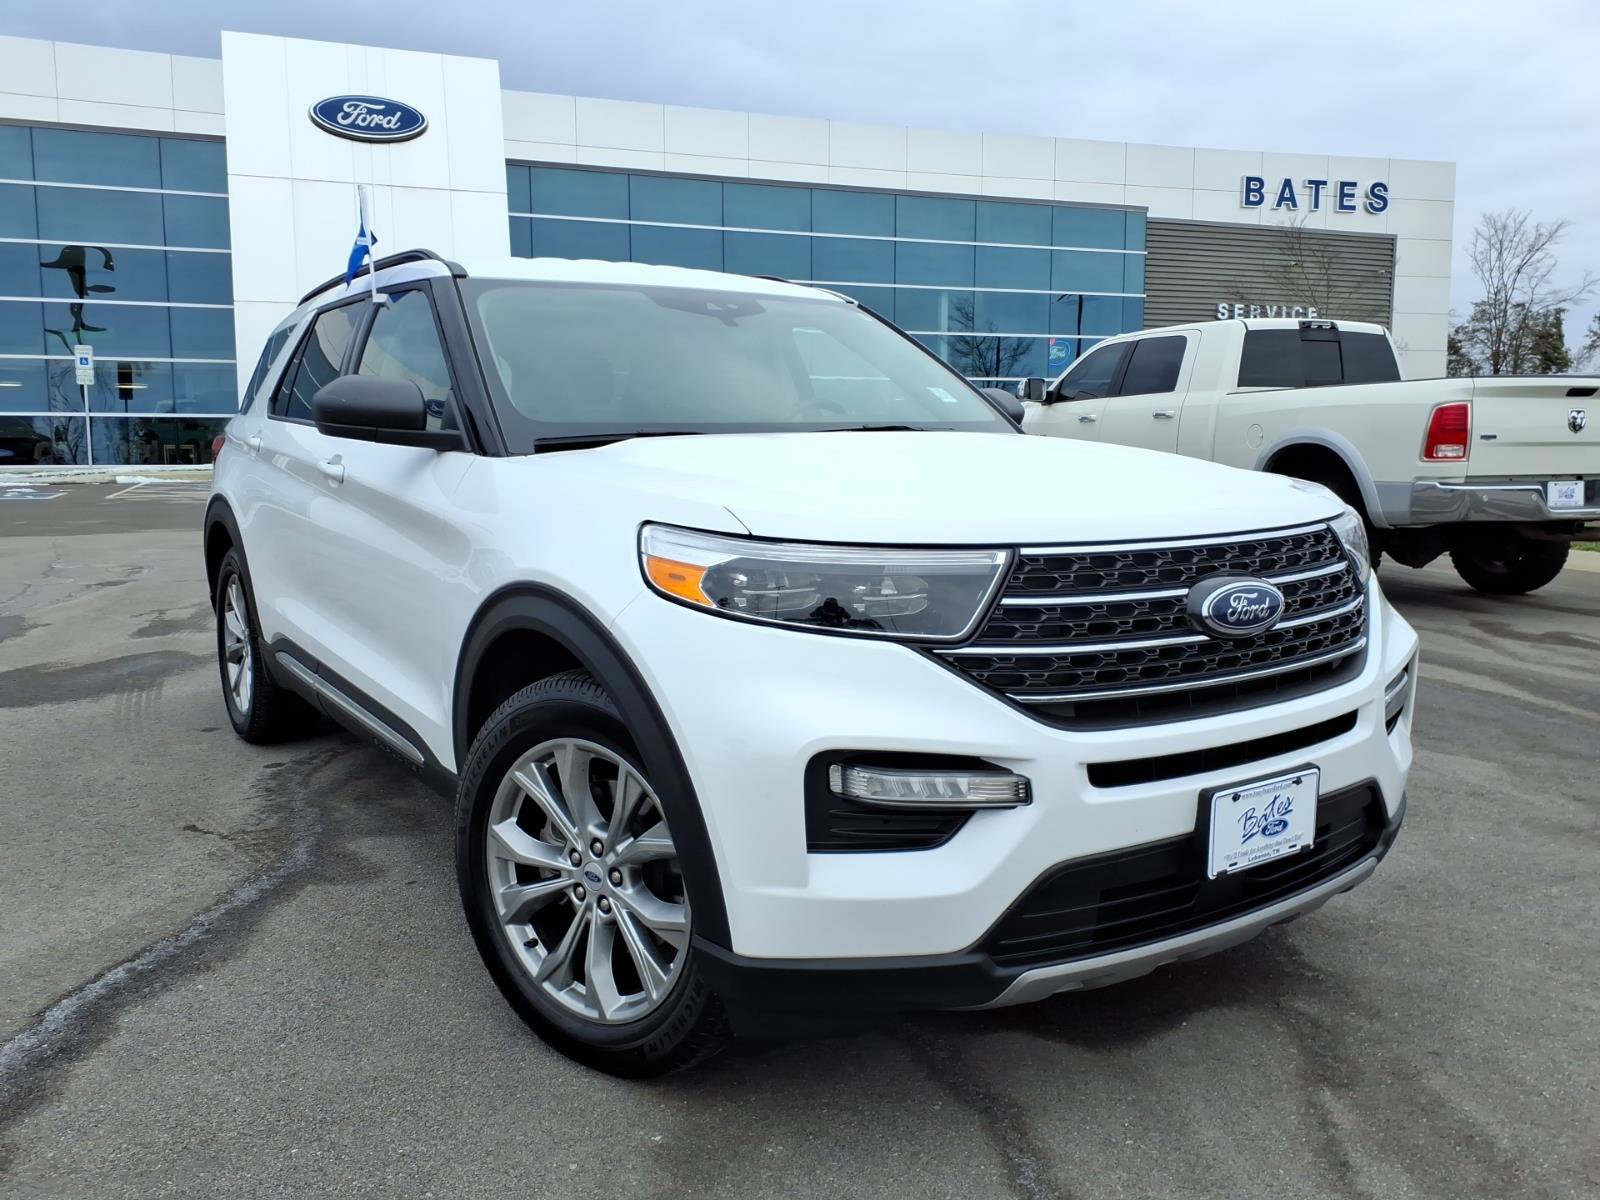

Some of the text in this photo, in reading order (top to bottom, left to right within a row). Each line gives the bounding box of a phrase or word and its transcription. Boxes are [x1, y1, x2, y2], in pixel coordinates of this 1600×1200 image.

[337, 101, 401, 129] Ford
[1242, 175, 1389, 214] BATES
[1216, 302, 1318, 321] SERVICE
[1227, 592, 1270, 623] Ford
[463, 725, 508, 800] MICHELIN
[1238, 794, 1294, 840] Bates
